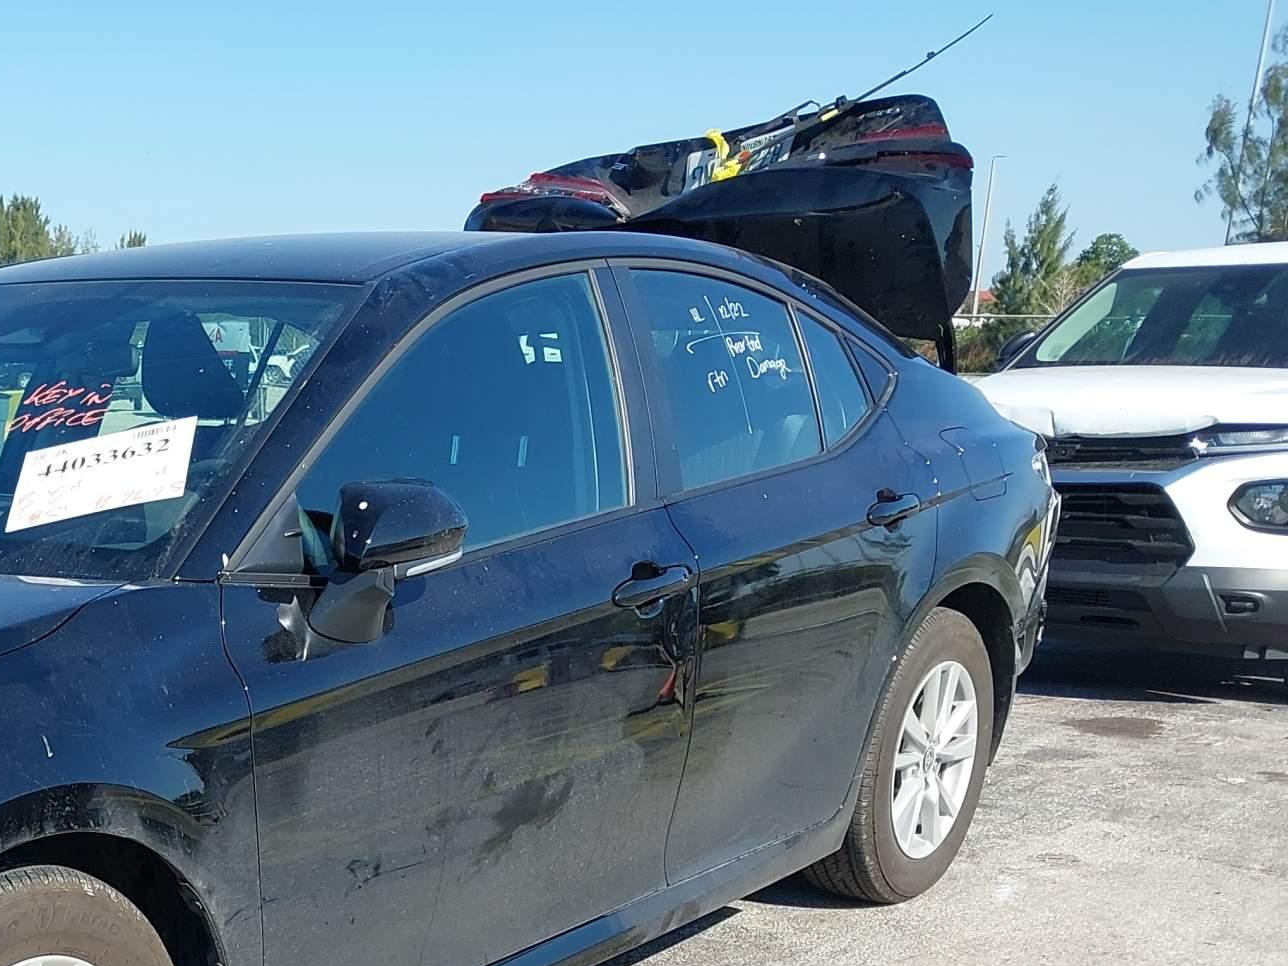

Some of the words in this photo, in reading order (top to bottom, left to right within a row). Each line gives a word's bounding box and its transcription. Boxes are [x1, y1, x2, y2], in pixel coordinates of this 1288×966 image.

[718, 296, 750, 320] 12/22
[746, 356, 792, 380] Damage
[23, 380, 85, 407] KEY
[4, 407, 109, 433] OFFICE
[38, 438, 170, 477] 44033632
